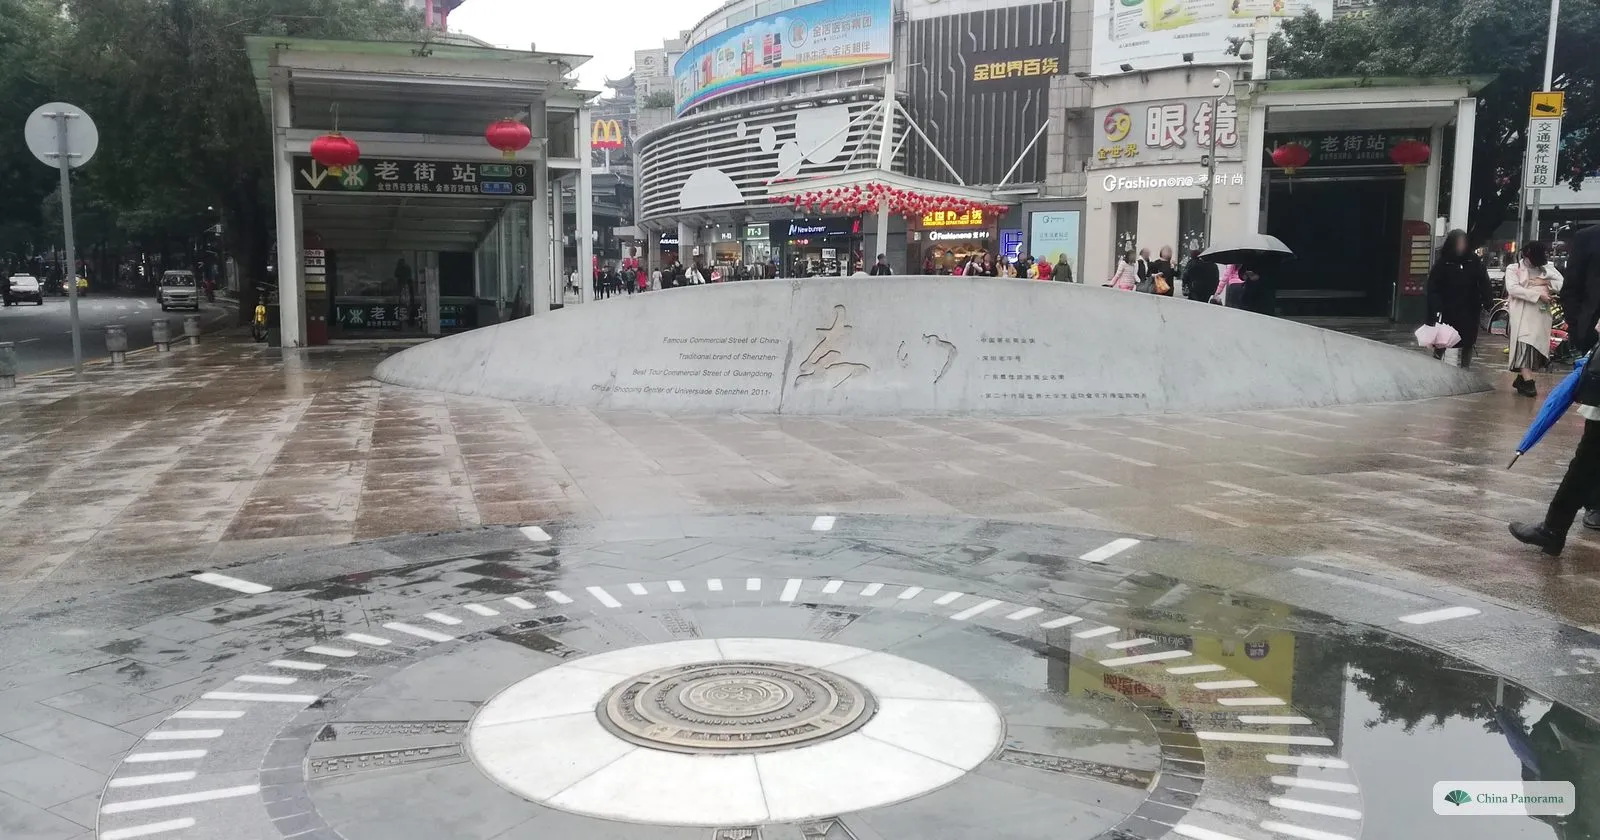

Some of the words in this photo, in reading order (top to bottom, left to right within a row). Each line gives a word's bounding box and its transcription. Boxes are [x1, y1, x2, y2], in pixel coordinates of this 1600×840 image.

[973, 57, 1059, 81] 金世界百货
[1146, 101, 1239, 149] 眼镜
[1320, 134, 1386, 152] 老街站
[1098, 144, 1139, 161] 金世界
[1532, 121, 1552, 185] 交通繁忙路段
[374, 161, 477, 183] 老街站
[712, 353, 732, 361] brand
[733, 353, 740, 361] of
[742, 353, 776, 361] Shenzhen
[663, 369, 700, 377] Commercial
[614, 385, 642, 394] Shopping
[643, 386, 665, 394] Center
[674, 387, 713, 396] Universiade
[715, 388, 749, 396] Shenzhen
